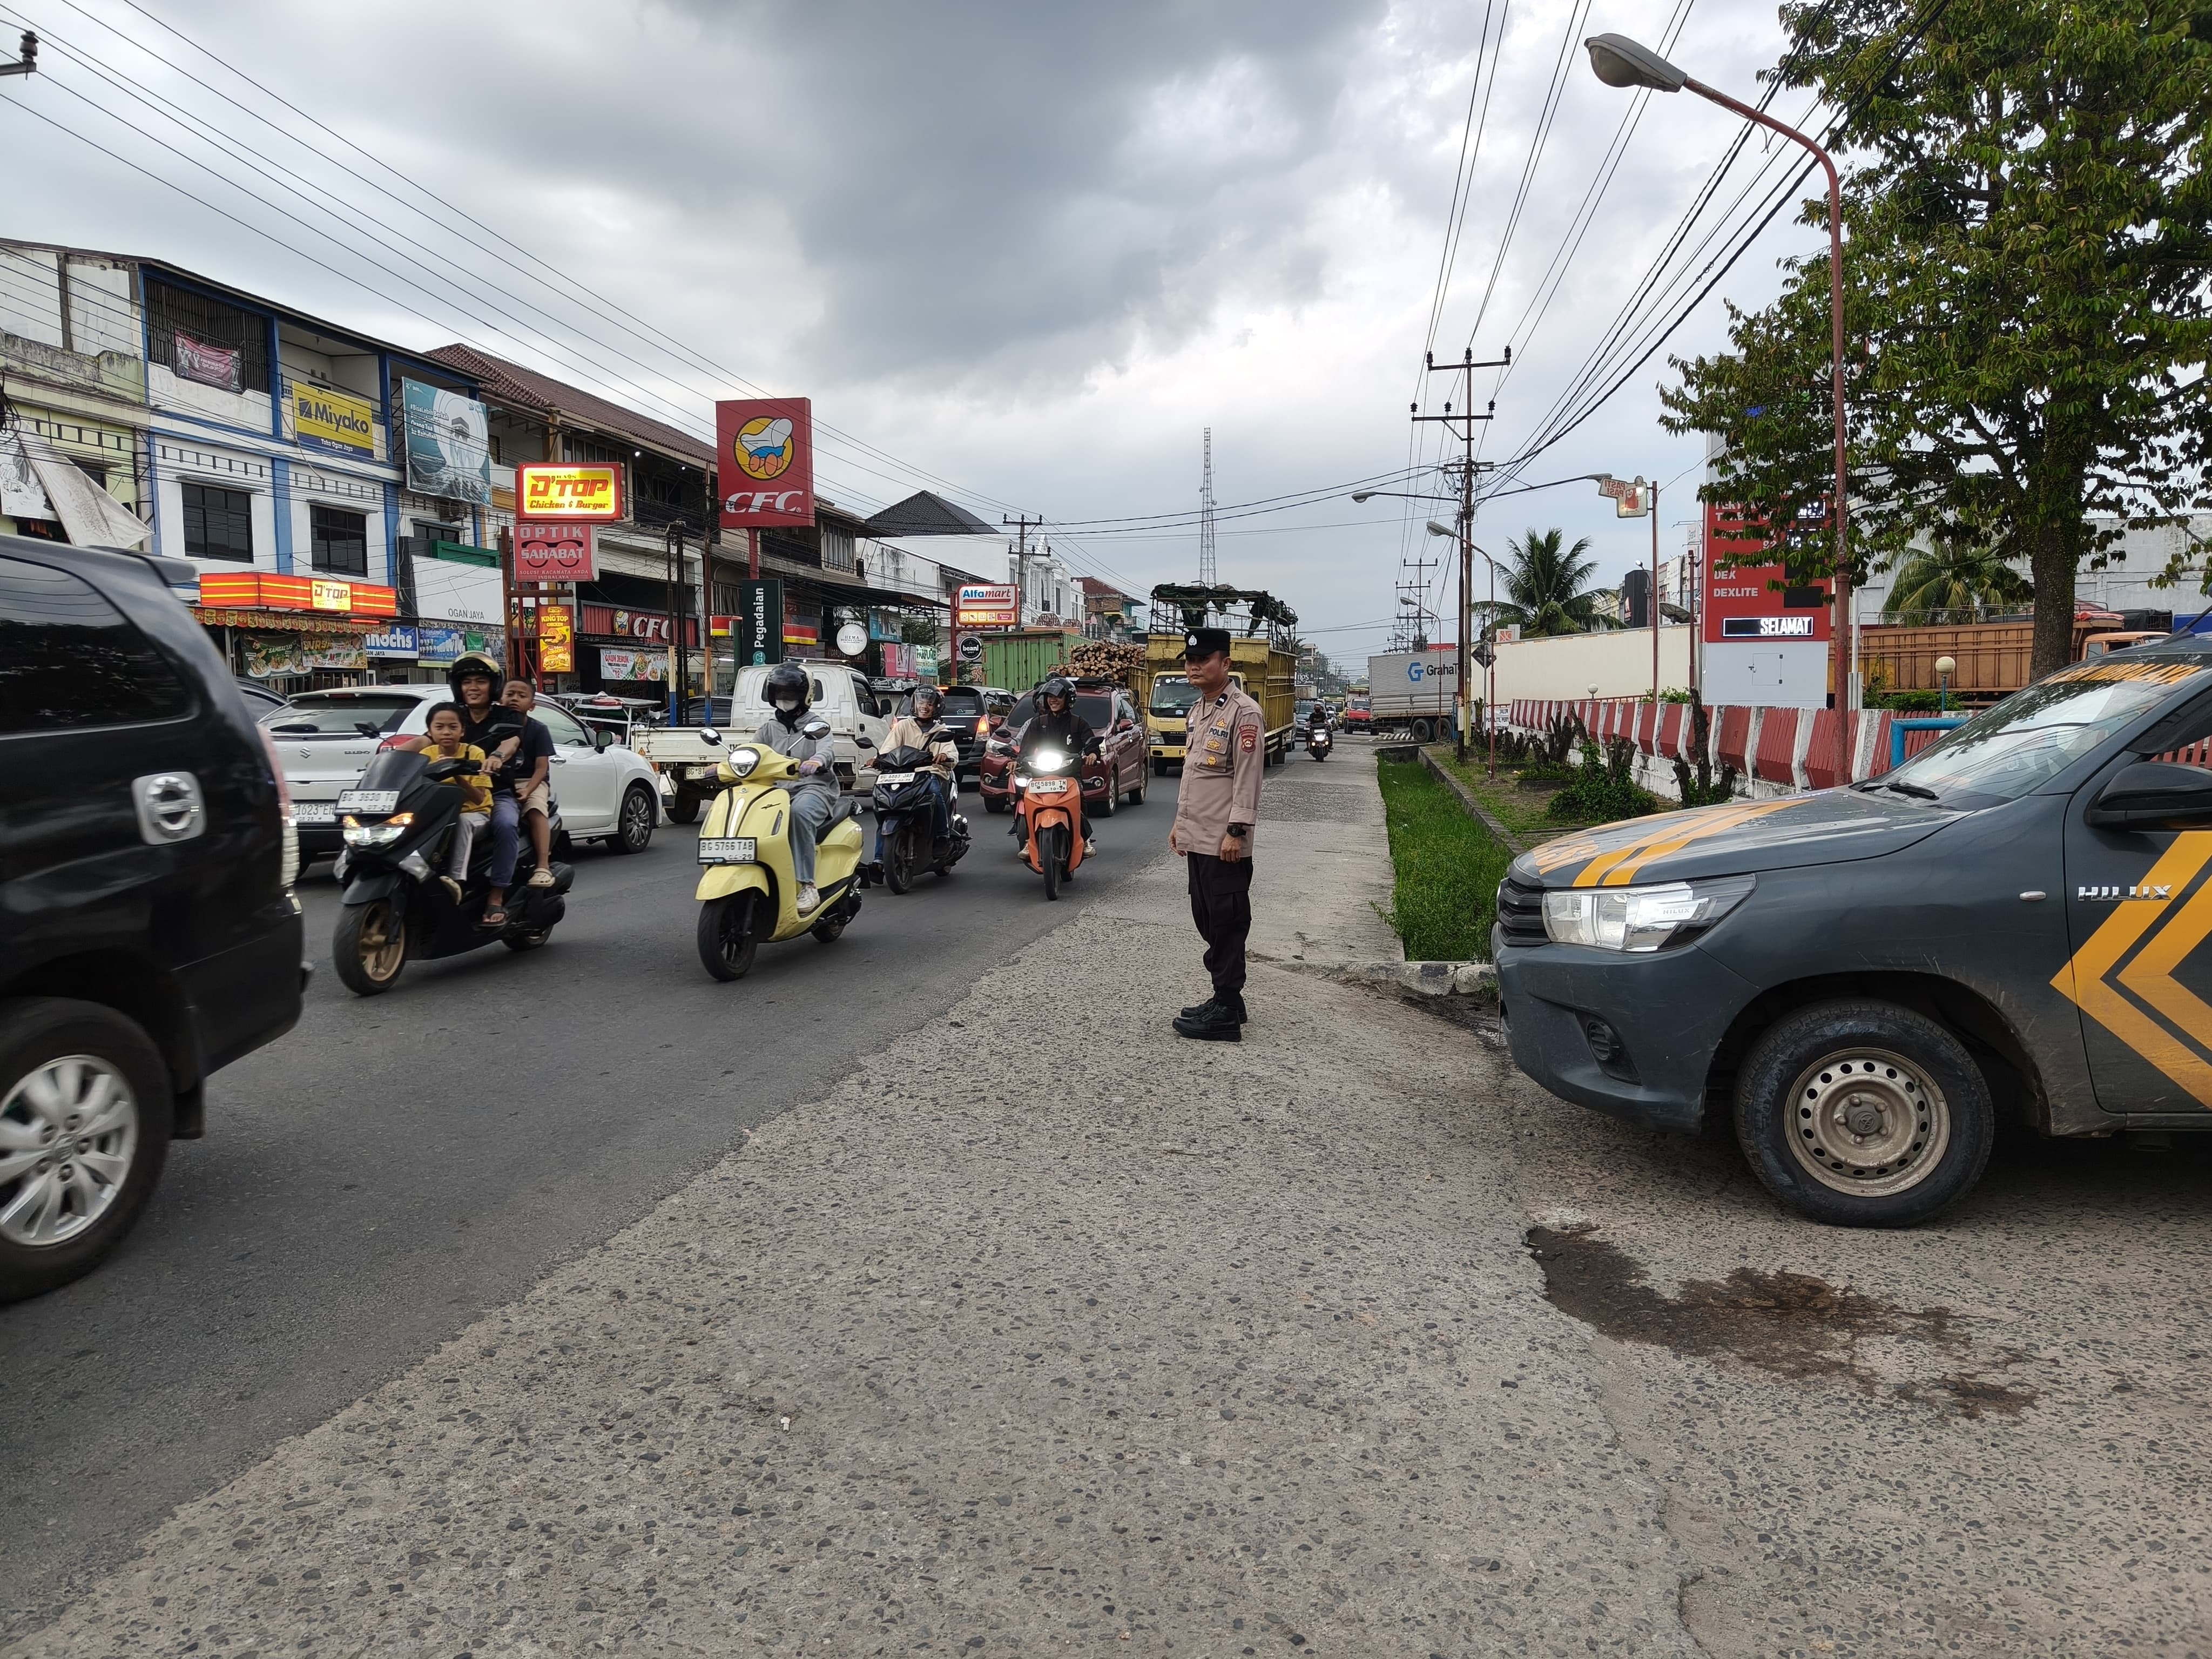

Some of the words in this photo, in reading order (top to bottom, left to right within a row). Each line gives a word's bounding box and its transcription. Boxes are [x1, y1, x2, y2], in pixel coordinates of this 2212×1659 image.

[315, 402, 369, 434] Miyako
[320, 438, 331, 447] Toko
[332, 441, 342, 449] Ogan
[530, 475, 609, 497] D'TOP
[529, 500, 565, 509] Chicken
[575, 500, 609, 510] Burger
[725, 490, 803, 514] CFC
[520, 527, 583, 538] OPTIK
[521, 549, 584, 559] SAHABAT
[1714, 570, 1736, 579] DEX
[962, 589, 1011, 598] Alfamart
[1714, 588, 1758, 597] DEXLITE
[448, 608, 468, 617] OGAN
[469, 610, 485, 620] JAYA
[753, 588, 767, 648] Pegadaian
[1760, 618, 1811, 635] SELAMAT
[366, 628, 413, 649] inochs
[1209, 727, 1229, 738] POLRI
[701, 842, 712, 851] BG
[715, 841, 734, 851] 5766
[737, 841, 753, 851] TAB
[2078, 884, 2172, 901] HILUX
